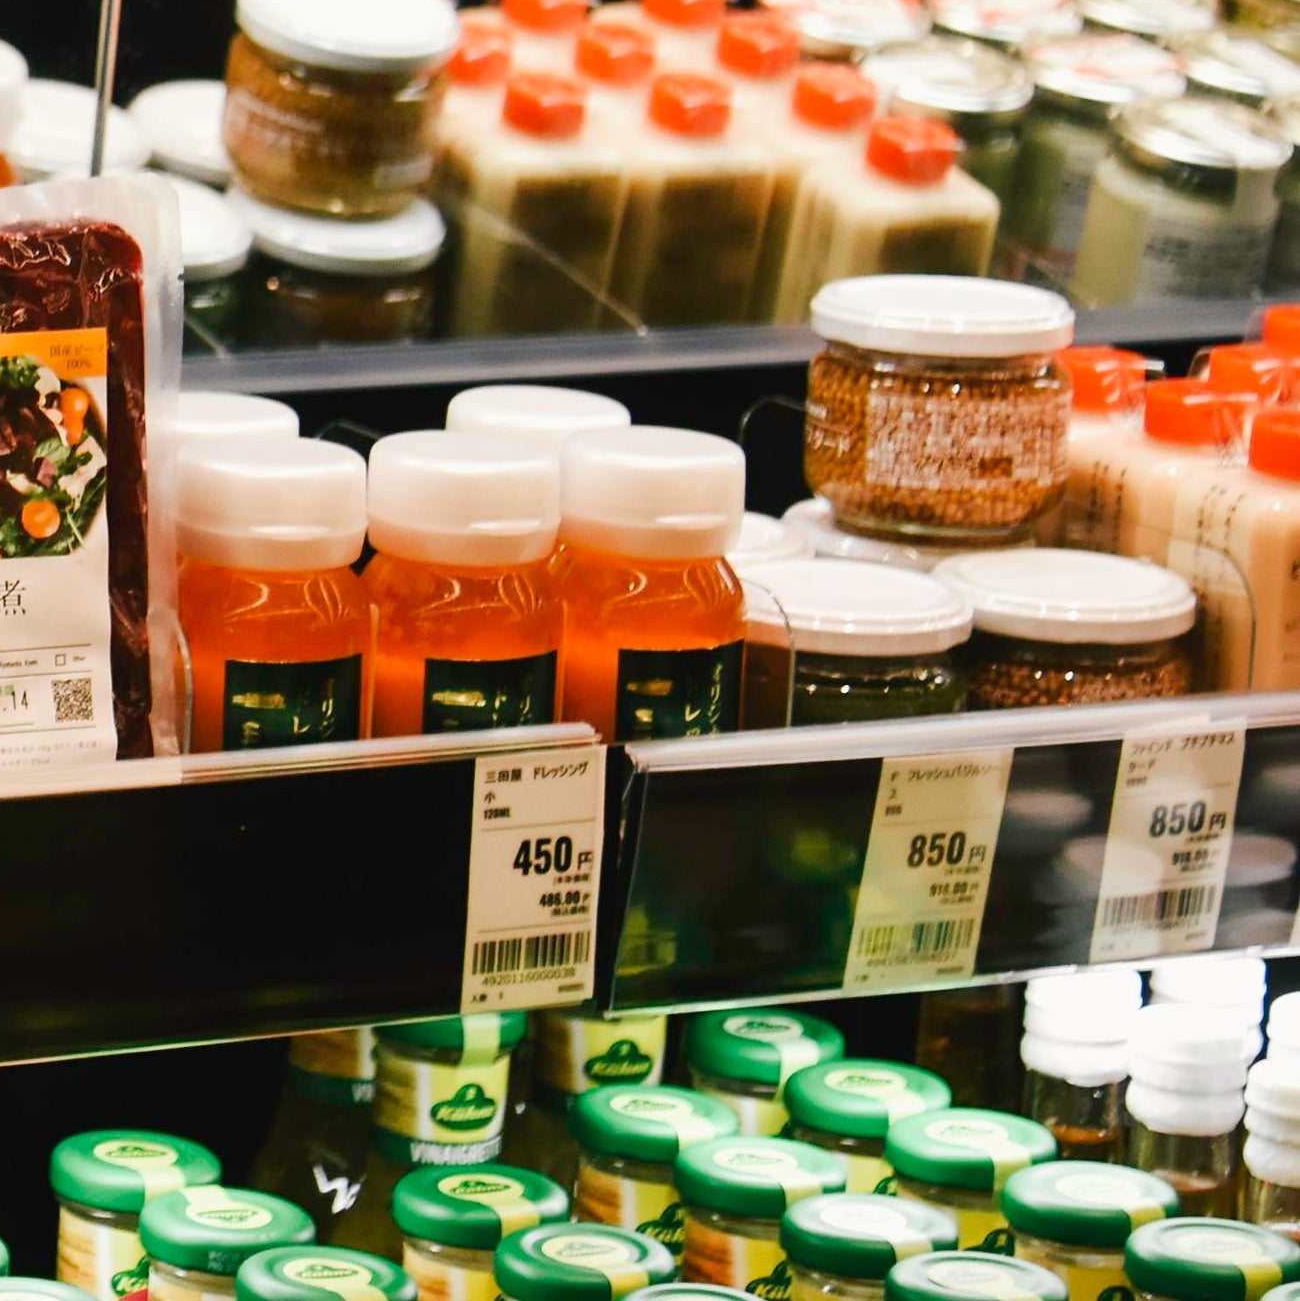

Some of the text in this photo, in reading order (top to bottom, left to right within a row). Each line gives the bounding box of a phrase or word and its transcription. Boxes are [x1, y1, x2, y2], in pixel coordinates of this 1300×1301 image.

[533, 760, 589, 780] ドレッシング
[1149, 800, 1208, 839] 850
[513, 835, 573, 876] 450
[907, 830, 967, 869] 850
